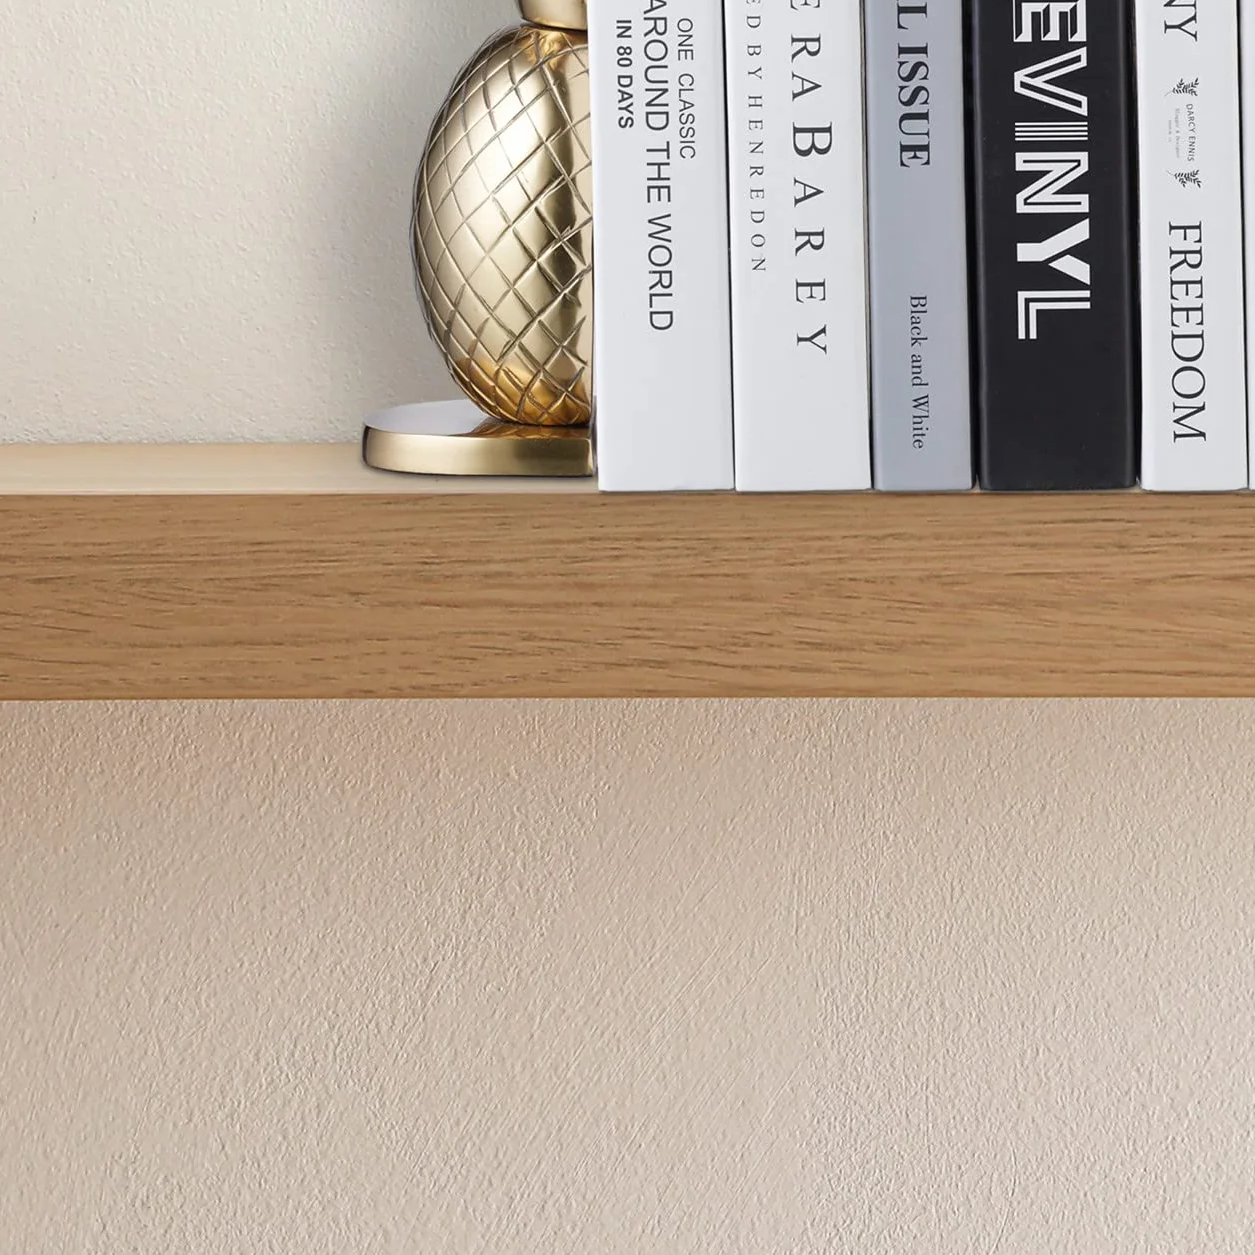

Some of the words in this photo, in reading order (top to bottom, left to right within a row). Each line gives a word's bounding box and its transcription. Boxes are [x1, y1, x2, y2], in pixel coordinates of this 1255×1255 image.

[616, 19, 633, 39] IN
[616, 45, 634, 68] 80
[676, 17, 695, 62] ONE
[746, 44, 763, 80] BY
[617, 74, 635, 129] DAYS
[677, 72, 697, 160] CLASSIC
[897, 42, 931, 169] ISSUE
[1185, 103, 1196, 134] DARCY
[646, 140, 672, 204] THE
[1186, 135, 1197, 162] ENNIS
[747, 95, 767, 272] HENREDON
[792, 121, 834, 355] BAREY
[647, 213, 674, 331] WORLD
[909, 295, 929, 347] Black
[1168, 220, 1207, 444] FREEDOM
[910, 353, 930, 387] and
[911, 393, 930, 449] White
